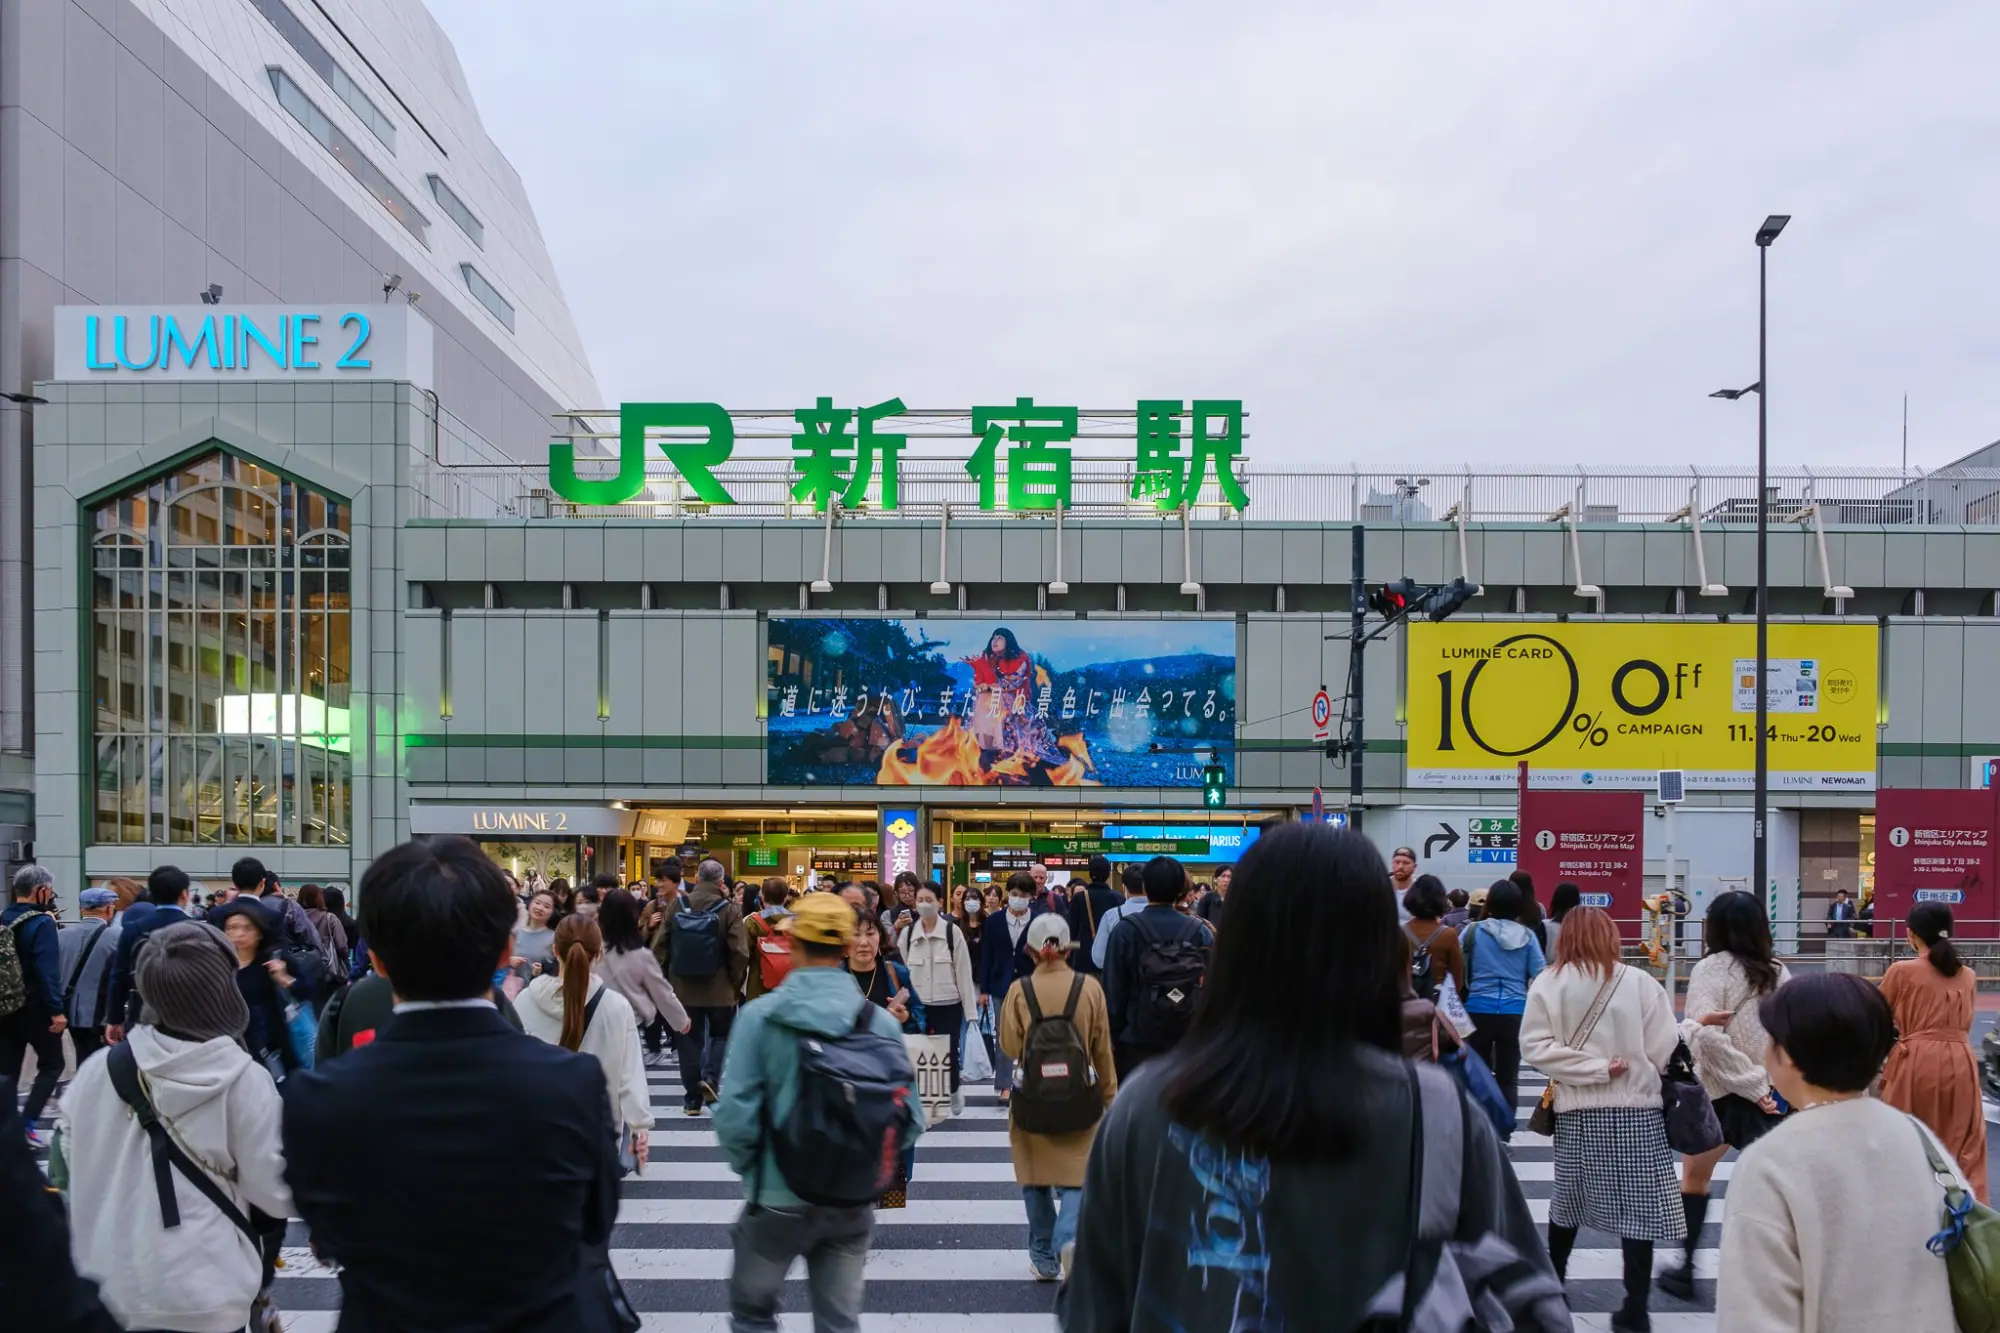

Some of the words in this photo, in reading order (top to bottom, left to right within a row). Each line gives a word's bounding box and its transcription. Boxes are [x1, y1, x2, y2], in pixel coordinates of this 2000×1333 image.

[86, 314, 321, 370] LUMINE
[336, 312, 373, 369] 2
[549, 402, 737, 505] JR
[791, 396, 1251, 513] 新宿駅
[1441, 647, 1502, 659] LUMINE
[1507, 647, 1553, 659] CARD
[1617, 723, 1703, 735] CAMPAIGN
[1727, 724, 1778, 743] 11.4
[1781, 733, 1798, 743] Thu
[1839, 733, 1861, 743] Wed
[1782, 776, 1813, 785] LUMINE
[473, 811, 550, 831] LUMINE
[555, 812, 568, 831] 2
[1560, 832, 1636, 843] 新宿区エリアマップ
[1914, 830, 1988, 839] 新宿区エリアマップ
[1560, 842, 1588, 850] Shinjuku
[1589, 842, 1602, 850] City
[1603, 842, 1618, 850] Area
[1620, 842, 1635, 850] Map
[1914, 839, 1942, 847] Shinjuku
[1943, 839, 1956, 847] City
[1973, 839, 1988, 847] Map
